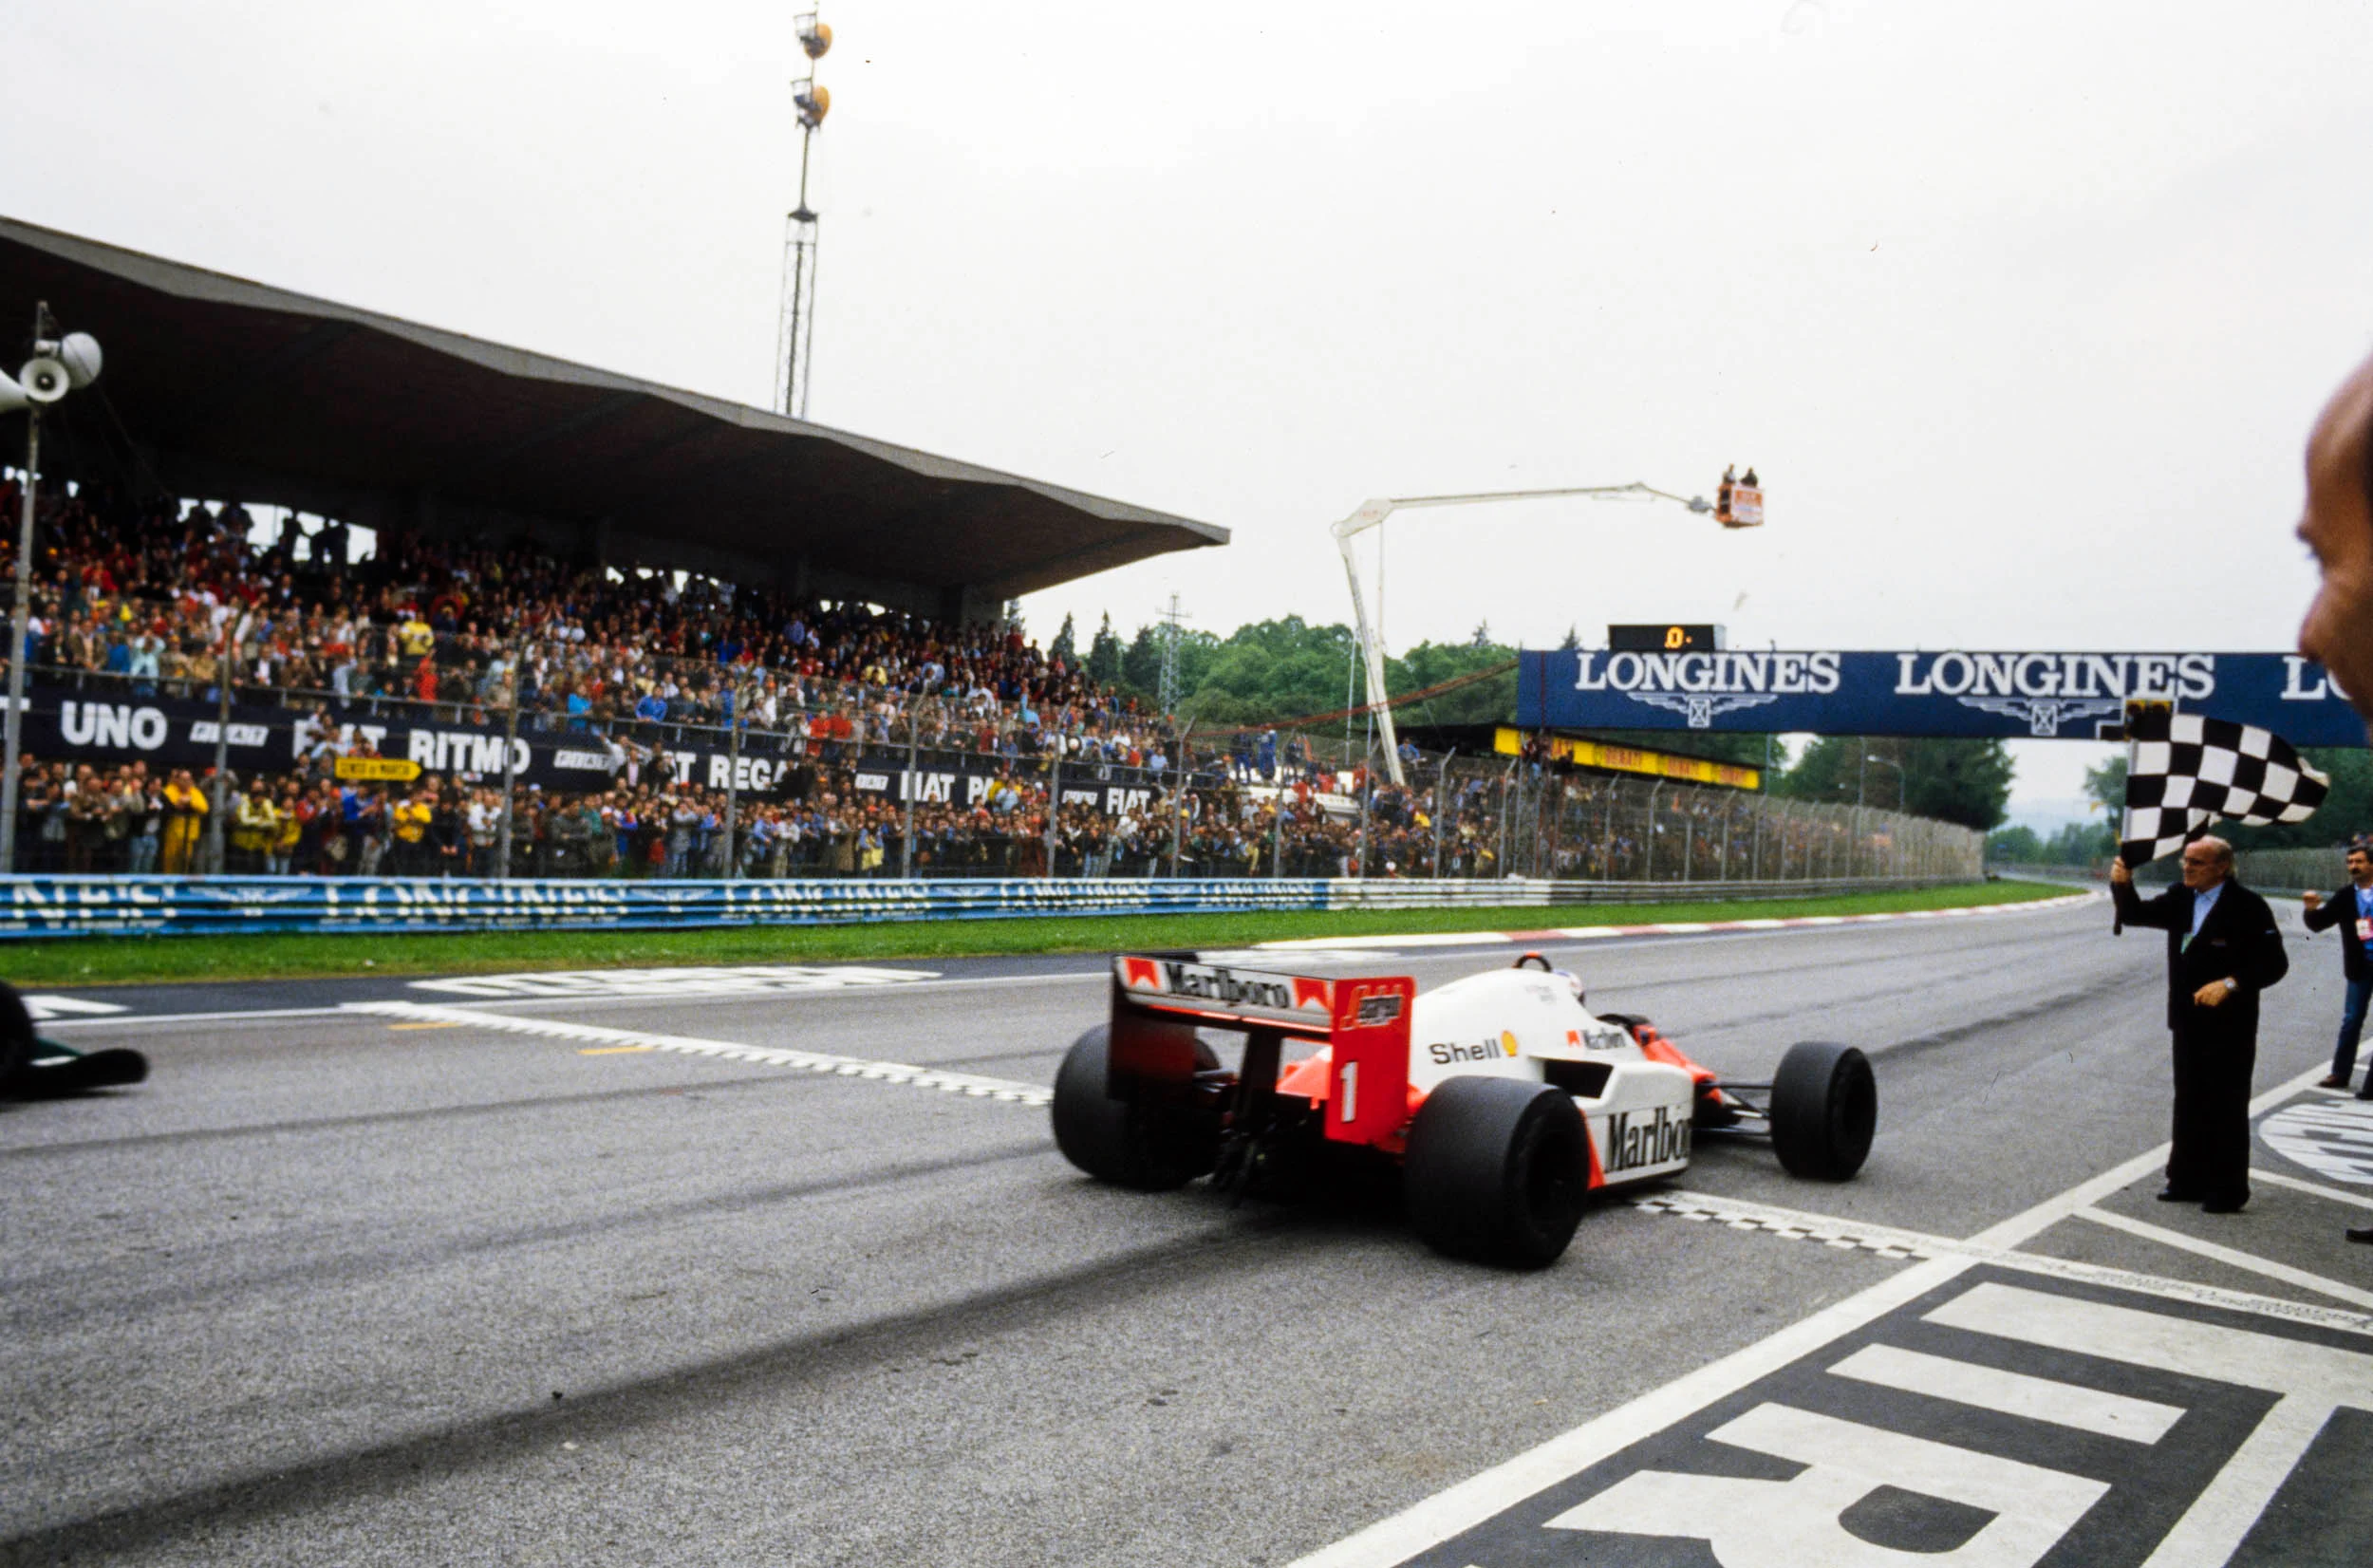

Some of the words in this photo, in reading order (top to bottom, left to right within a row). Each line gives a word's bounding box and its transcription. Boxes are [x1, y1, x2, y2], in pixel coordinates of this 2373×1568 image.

[1575, 651, 1840, 694] LONGINES
[1894, 652, 2215, 700] LONGINES
[61, 700, 168, 751] UNO
[408, 729, 532, 775] RITMO
[1106, 787, 1151, 816] FIAT
[1164, 961, 1293, 1009] Marlboro
[1429, 1037, 1501, 1065] Shell
[1339, 1060, 1359, 1123] 1
